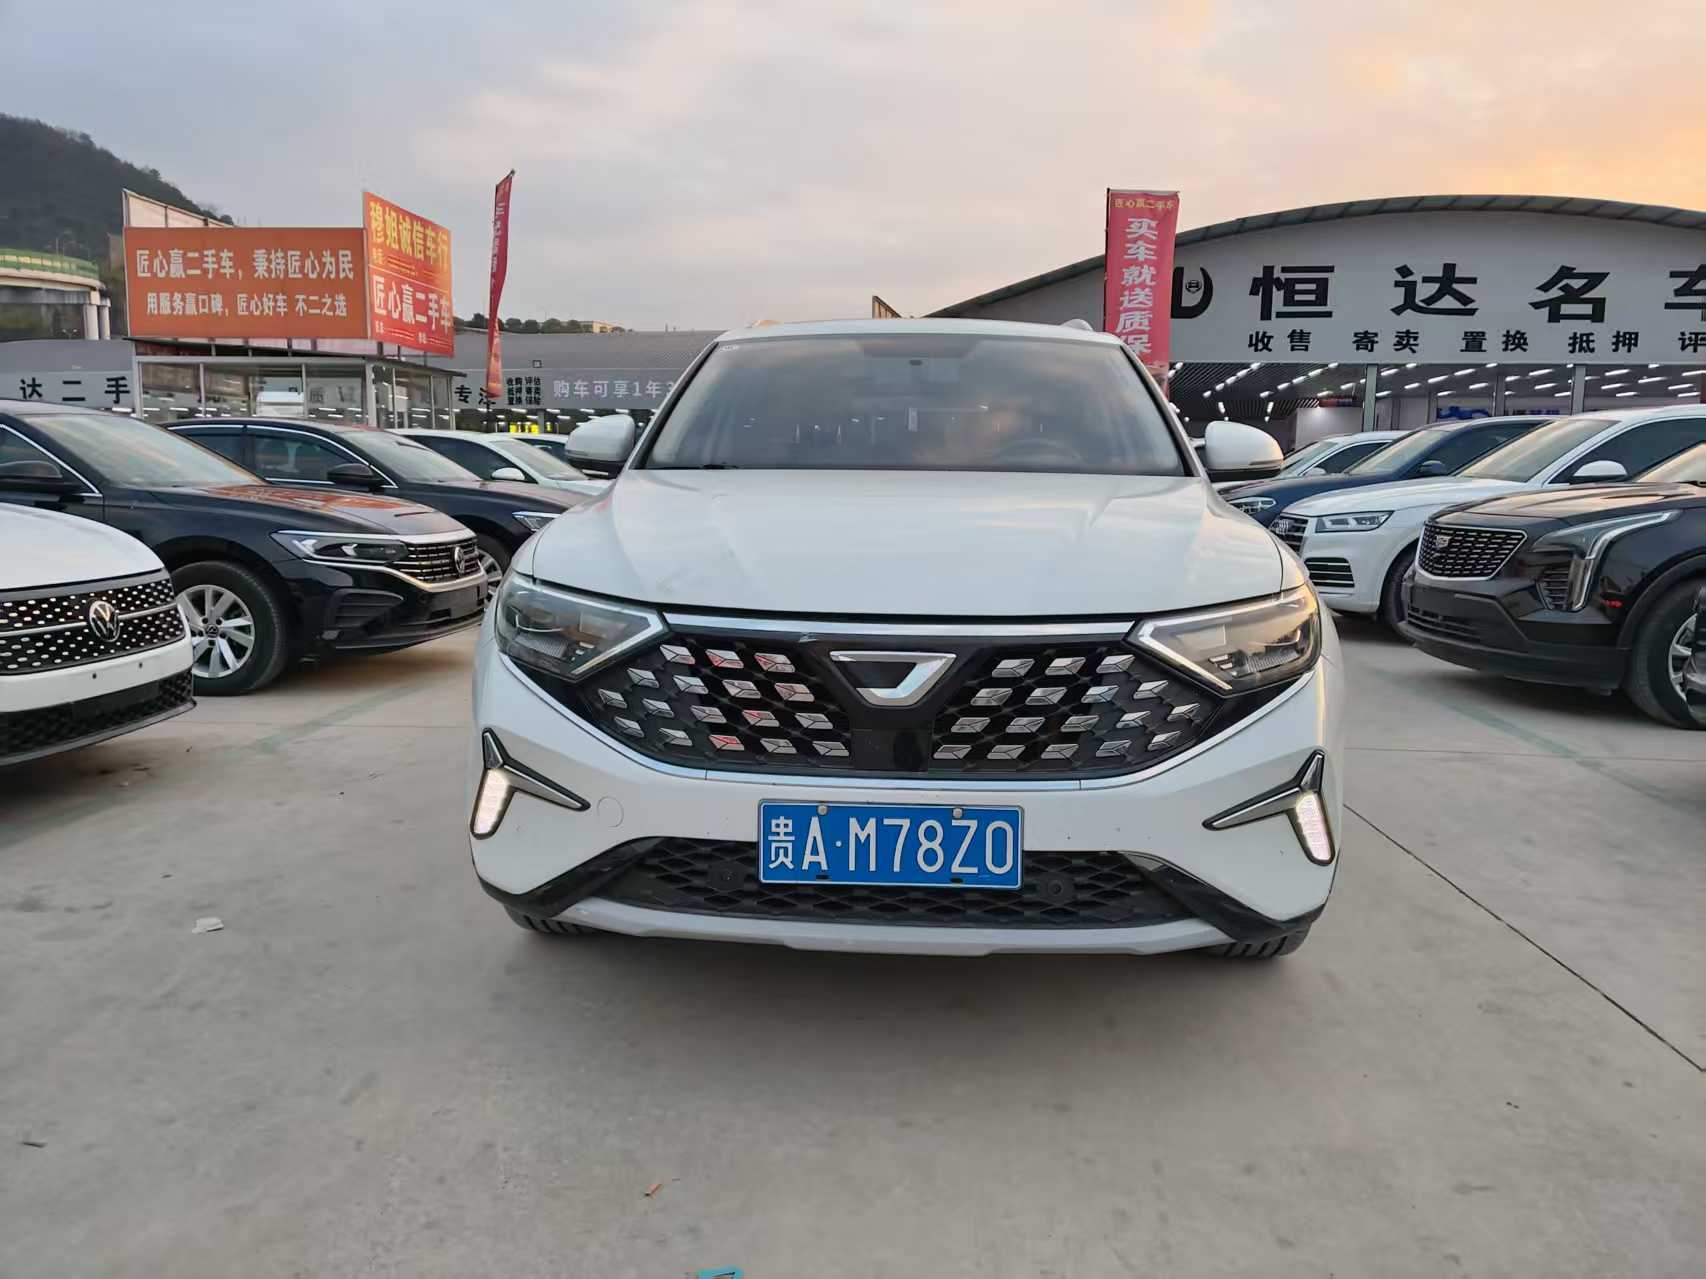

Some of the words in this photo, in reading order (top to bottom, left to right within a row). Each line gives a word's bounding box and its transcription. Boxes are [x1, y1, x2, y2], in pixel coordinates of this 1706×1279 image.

[1115, 217, 1159, 355] 买车就送质保
[1352, 329, 1420, 353] 寄卖
[1460, 329, 1529, 354] 置换
[1568, 330, 1639, 354] 抵押
